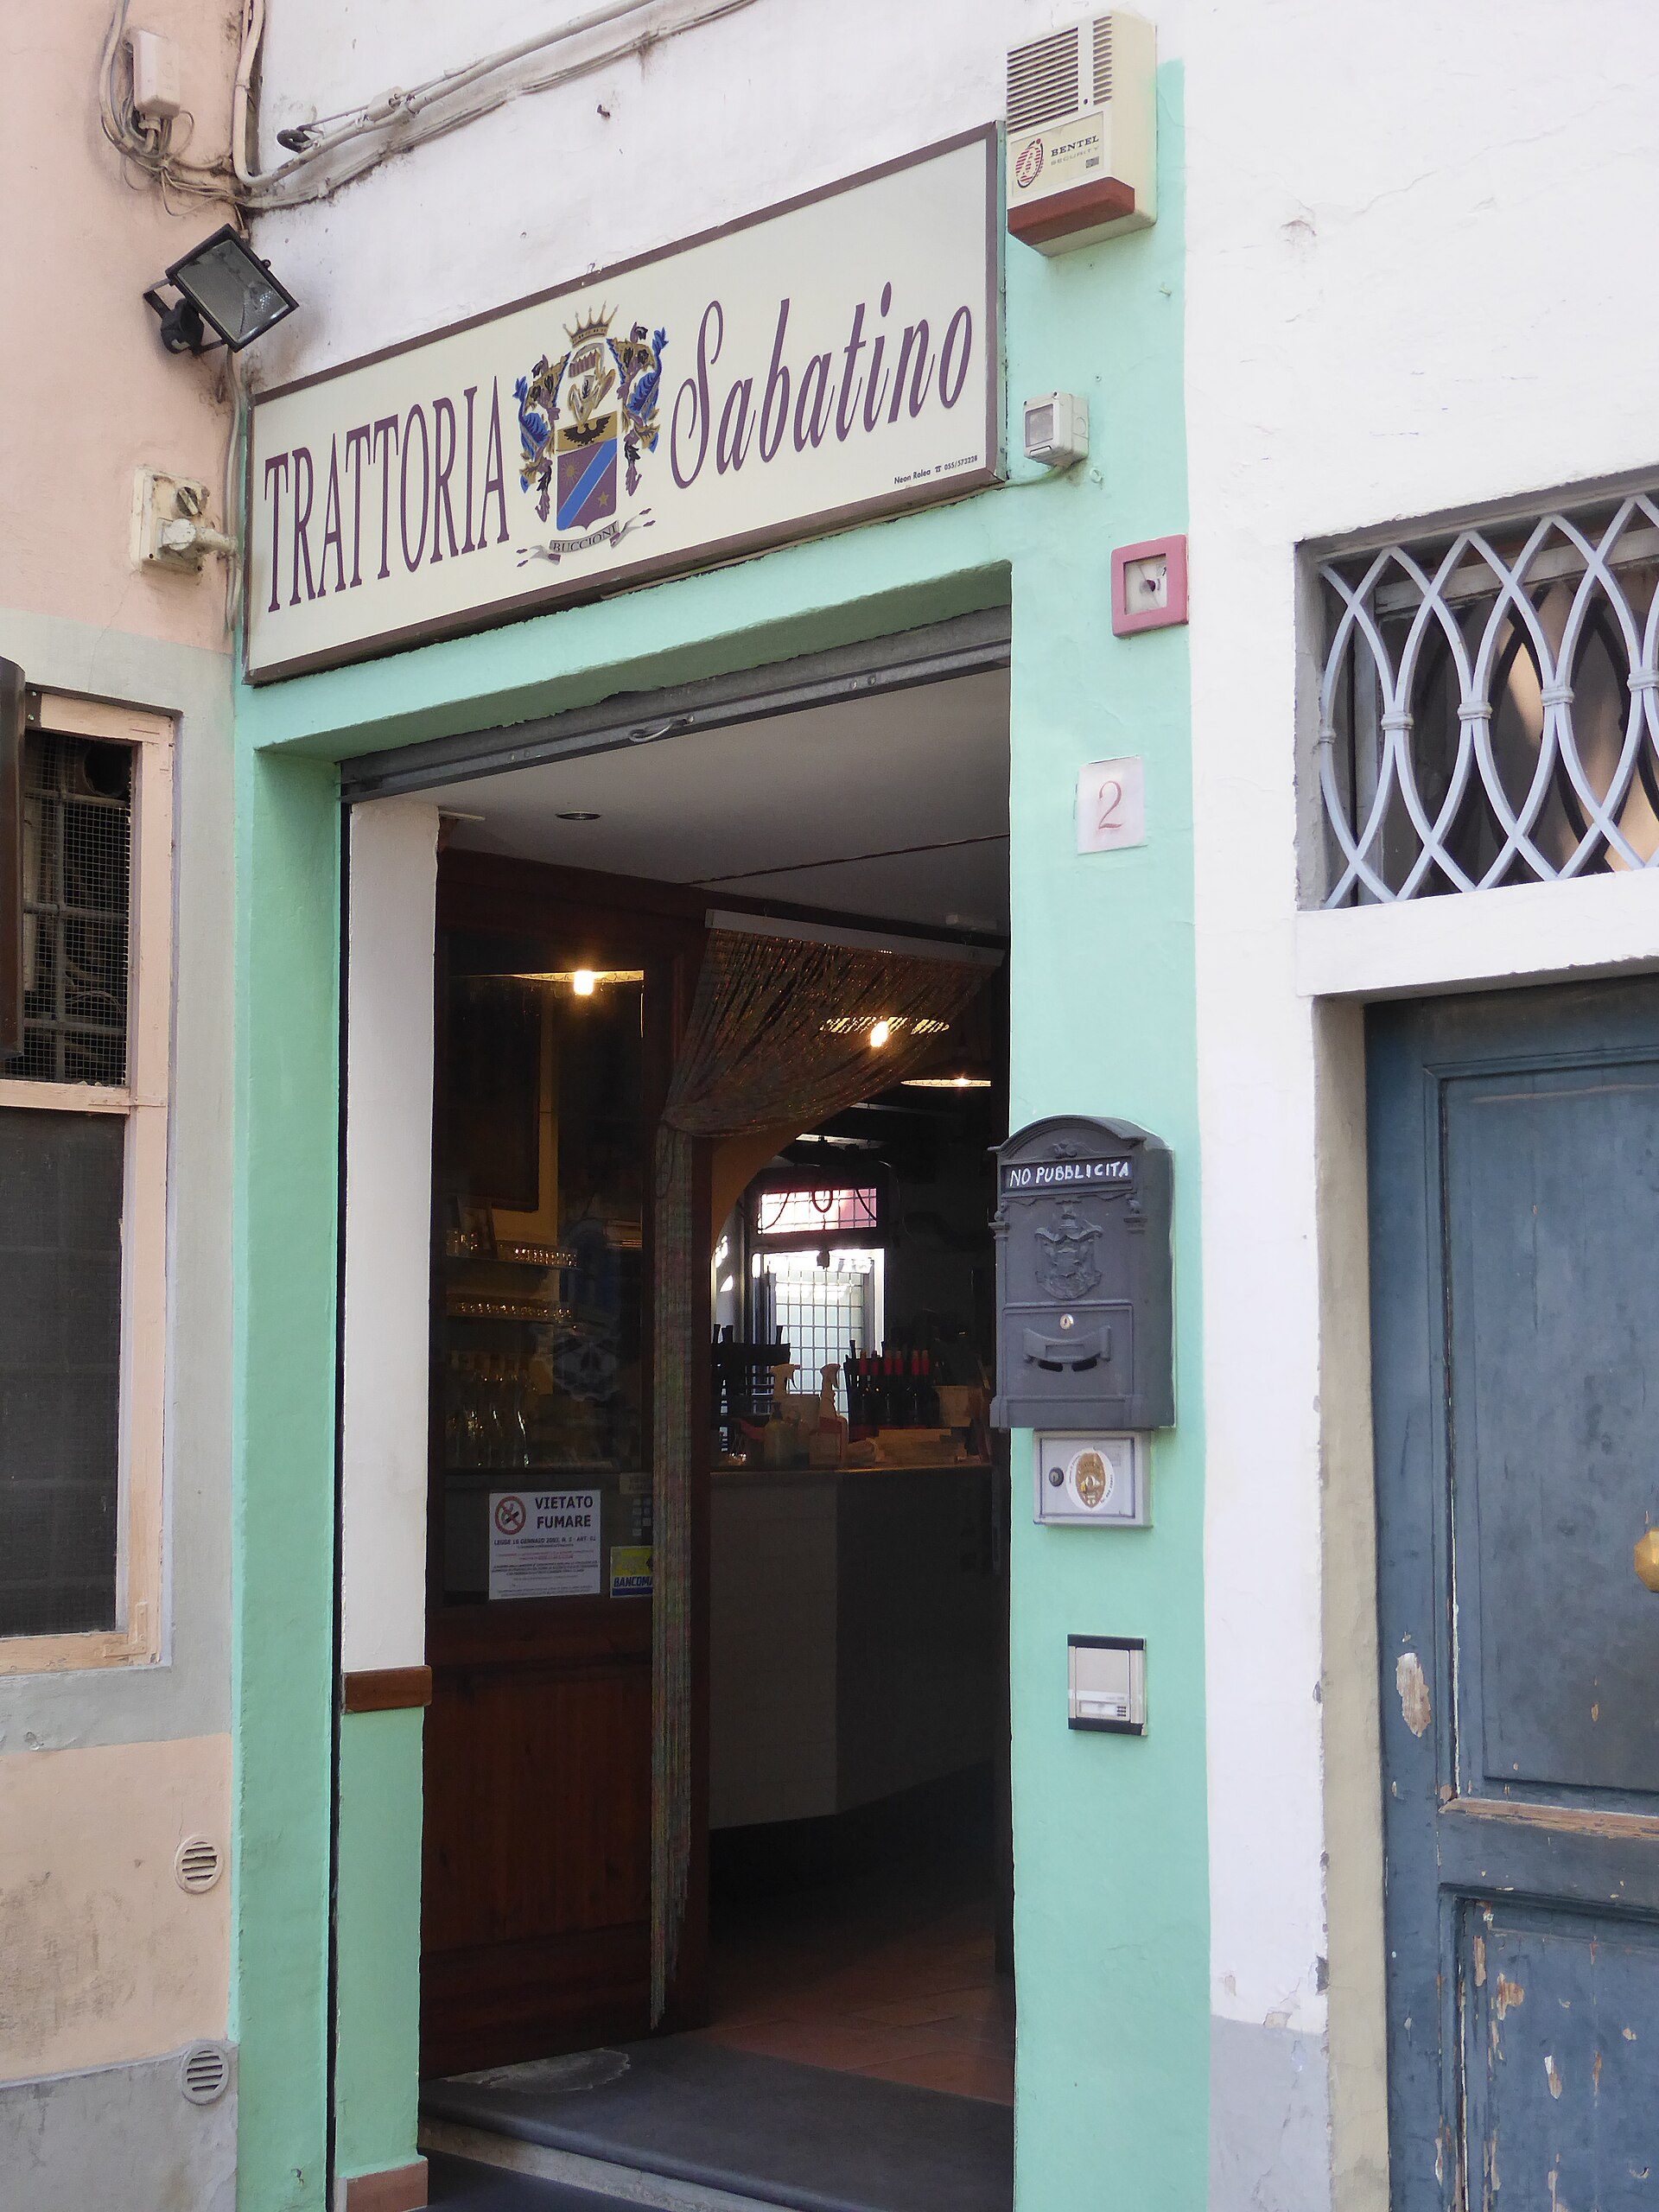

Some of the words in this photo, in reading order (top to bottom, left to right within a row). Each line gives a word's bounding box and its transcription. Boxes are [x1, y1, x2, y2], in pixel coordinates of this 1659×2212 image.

[1051, 135, 1099, 157] BENTEL
[1051, 146, 1098, 166] SECURITY
[264, 376, 510, 613] TRATTORIA
[670, 281, 972, 489] Sabatino
[894, 474, 912, 485] Neon
[554, 524, 614, 551] BUCCIONI
[1098, 780, 1122, 830] 2
[1009, 1167, 1031, 1187] NO
[1036, 1161, 1128, 1183] PUBBLICITA
[535, 1496, 594, 1510] VIETATO
[537, 1515, 592, 1529] FUMARE
